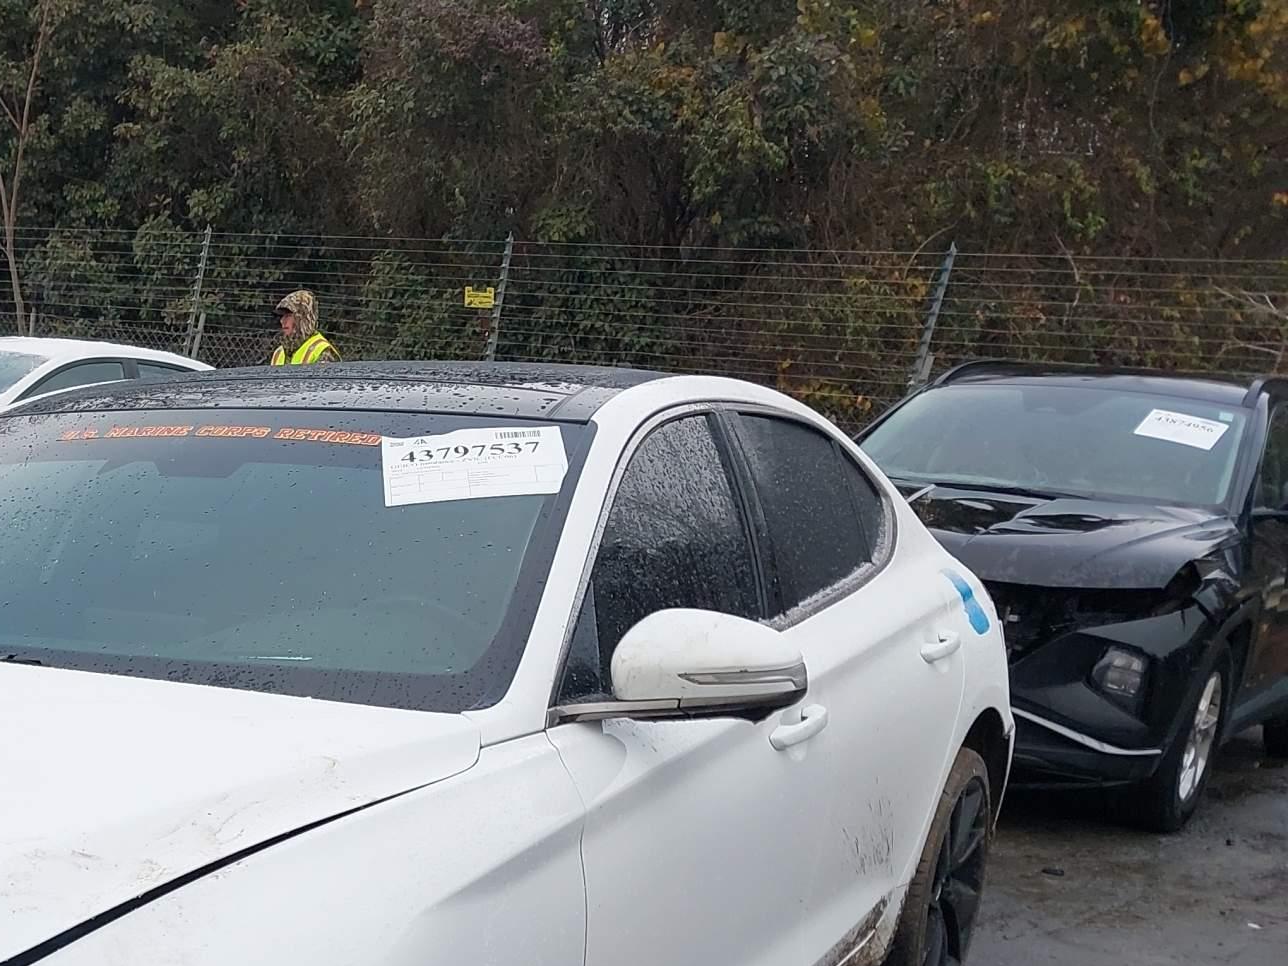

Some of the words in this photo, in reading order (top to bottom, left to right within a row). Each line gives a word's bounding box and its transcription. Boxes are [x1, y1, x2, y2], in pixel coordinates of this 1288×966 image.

[104, 425, 193, 438] MARINE
[195, 425, 272, 438] CORPS
[273, 427, 382, 447] RETIRED
[400, 441, 540, 463] 43797537
